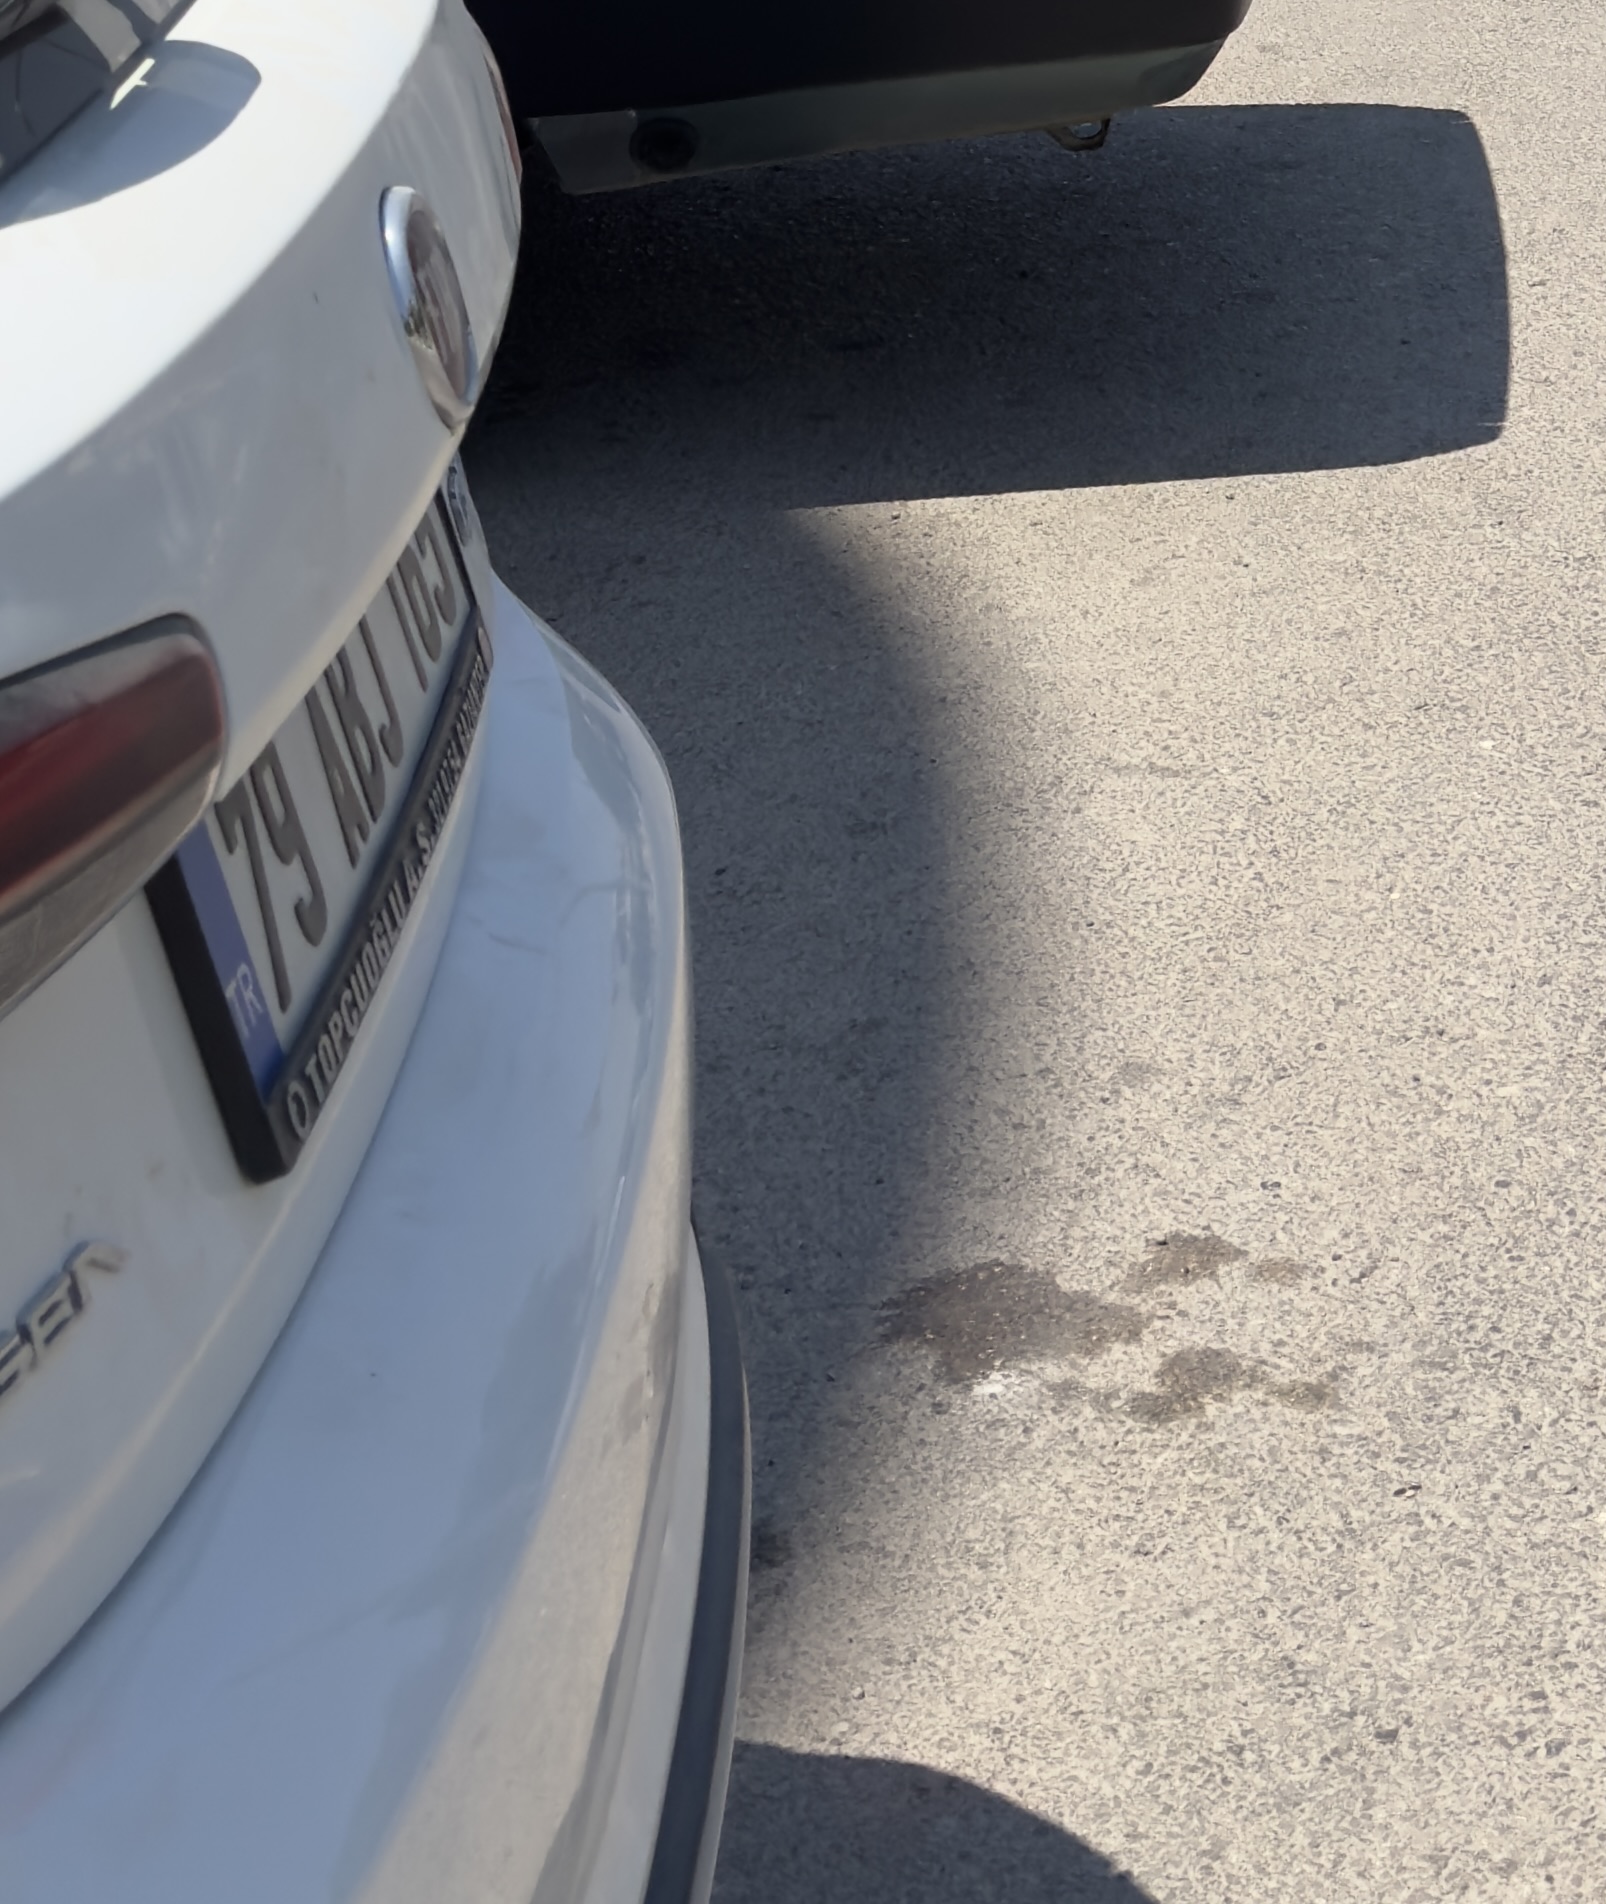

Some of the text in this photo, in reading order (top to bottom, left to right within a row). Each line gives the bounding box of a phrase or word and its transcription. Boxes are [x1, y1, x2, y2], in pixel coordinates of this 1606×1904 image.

[214, 741, 327, 1015] 79
[304, 878, 410, 1109] TOPCUOĞLU
[225, 962, 263, 1038] TR
